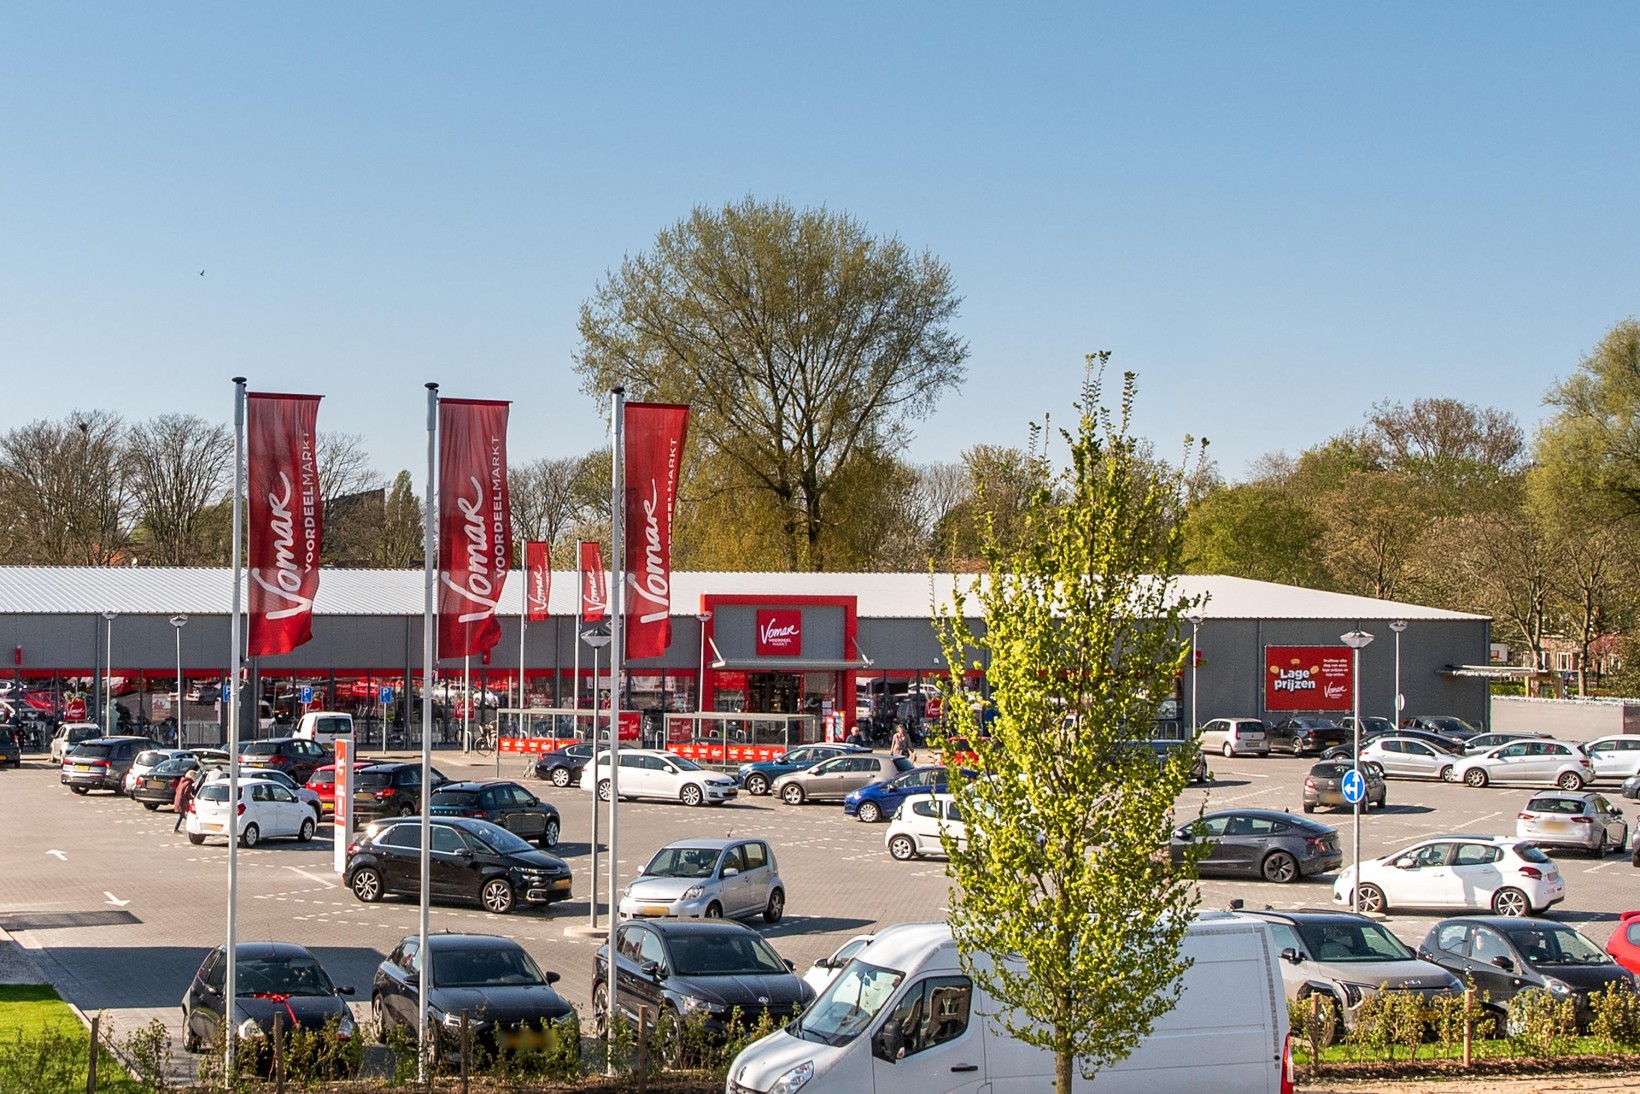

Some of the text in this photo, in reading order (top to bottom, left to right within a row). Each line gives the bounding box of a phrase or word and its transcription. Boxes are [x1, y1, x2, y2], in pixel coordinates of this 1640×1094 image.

[302, 432, 316, 574] VOORDEELMARKT
[491, 435, 506, 579] VOORDEELMARKT
[667, 438, 678, 569] DEELMARKT
[251, 471, 312, 620] Vomar
[441, 476, 496, 623] Vomar
[627, 478, 669, 624] Vomar
[528, 564, 547, 611] Vomar
[583, 565, 606, 611] Vomar
[761, 618, 800, 645] Vomar
[303, 687, 310, 697] P
[382, 687, 389, 697] P
[1274, 680, 1316, 692] prijzen
[1280, 669, 1310, 680] Lage
